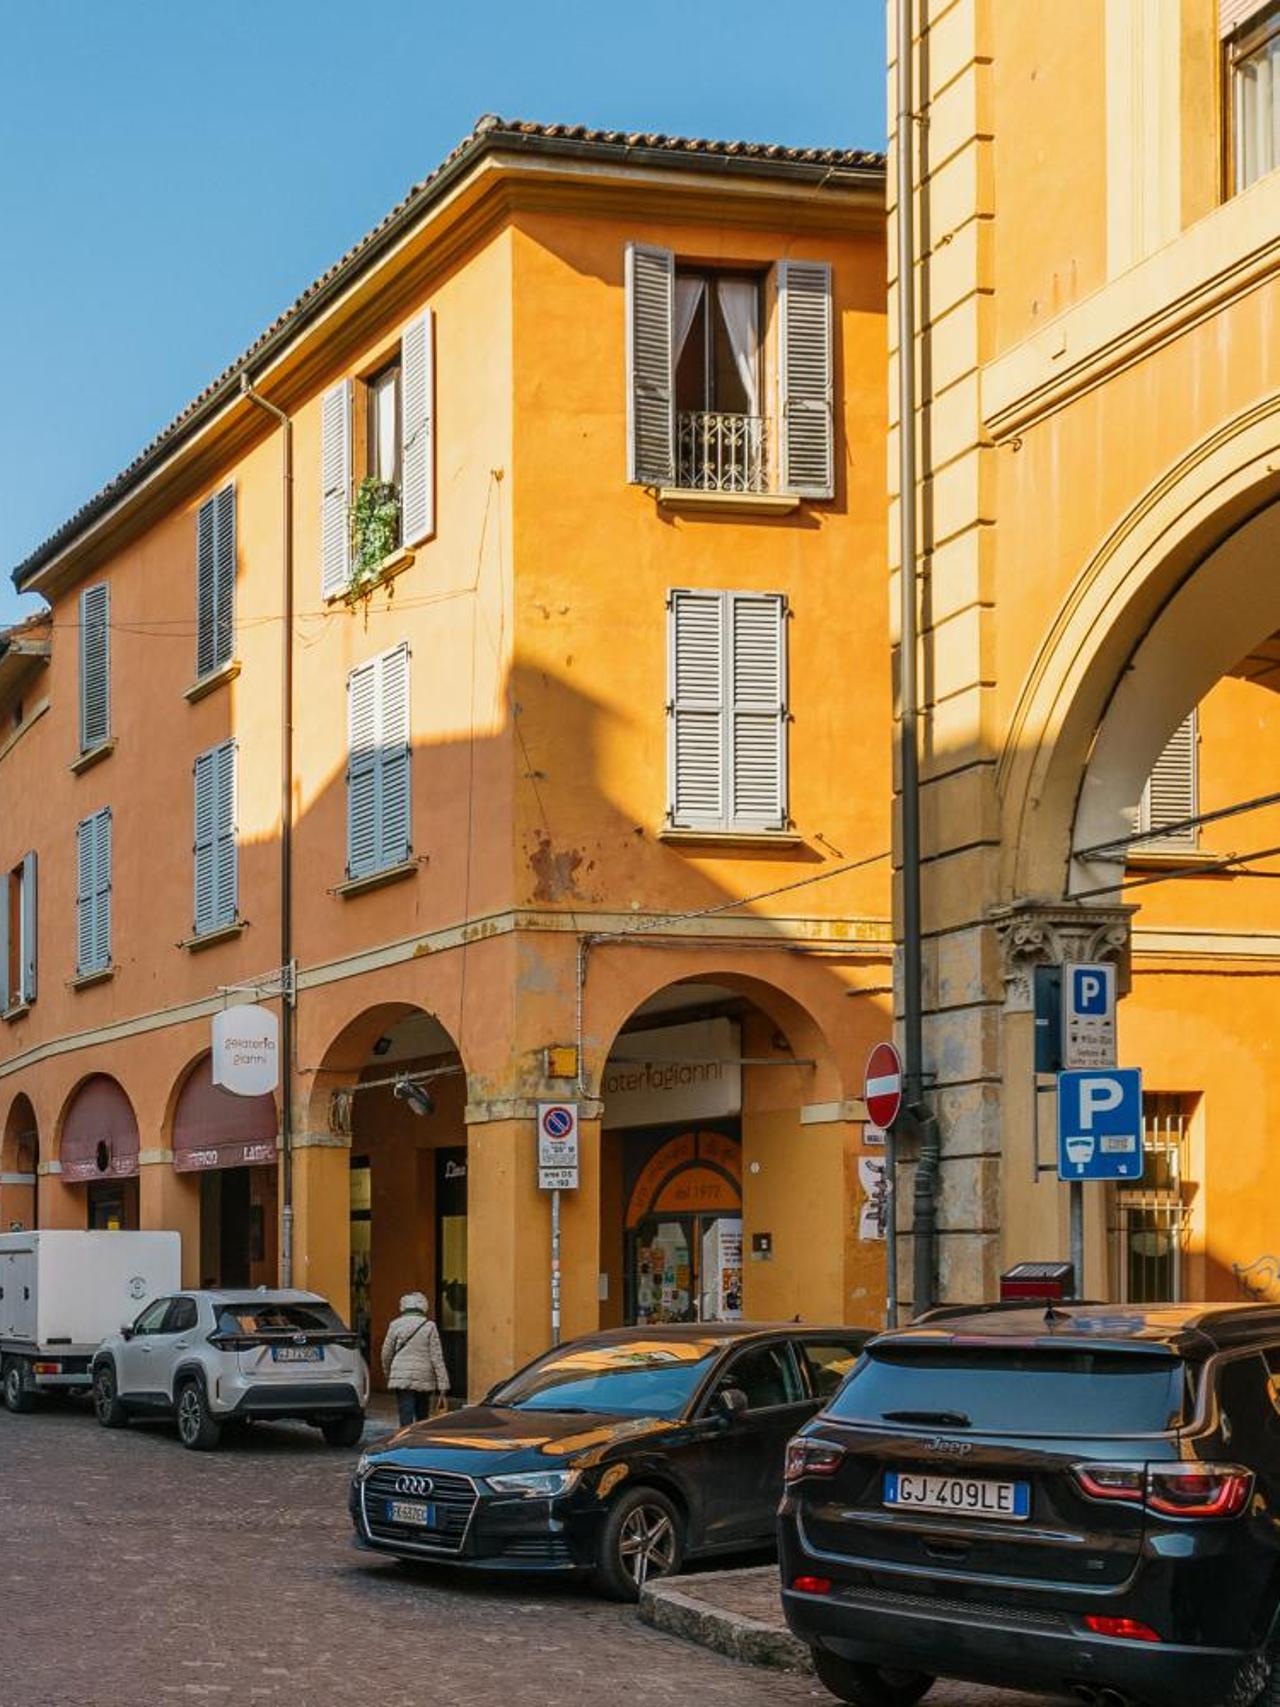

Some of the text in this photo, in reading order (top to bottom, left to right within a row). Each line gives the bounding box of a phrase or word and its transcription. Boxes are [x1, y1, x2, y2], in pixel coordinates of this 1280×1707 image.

[1081, 976, 1100, 1007] P
[224, 1037, 275, 1051] gelateria
[232, 1054, 268, 1066] gianni
[1080, 1078, 1124, 1129] P
[924, 1436, 972, 1456] Jeep
